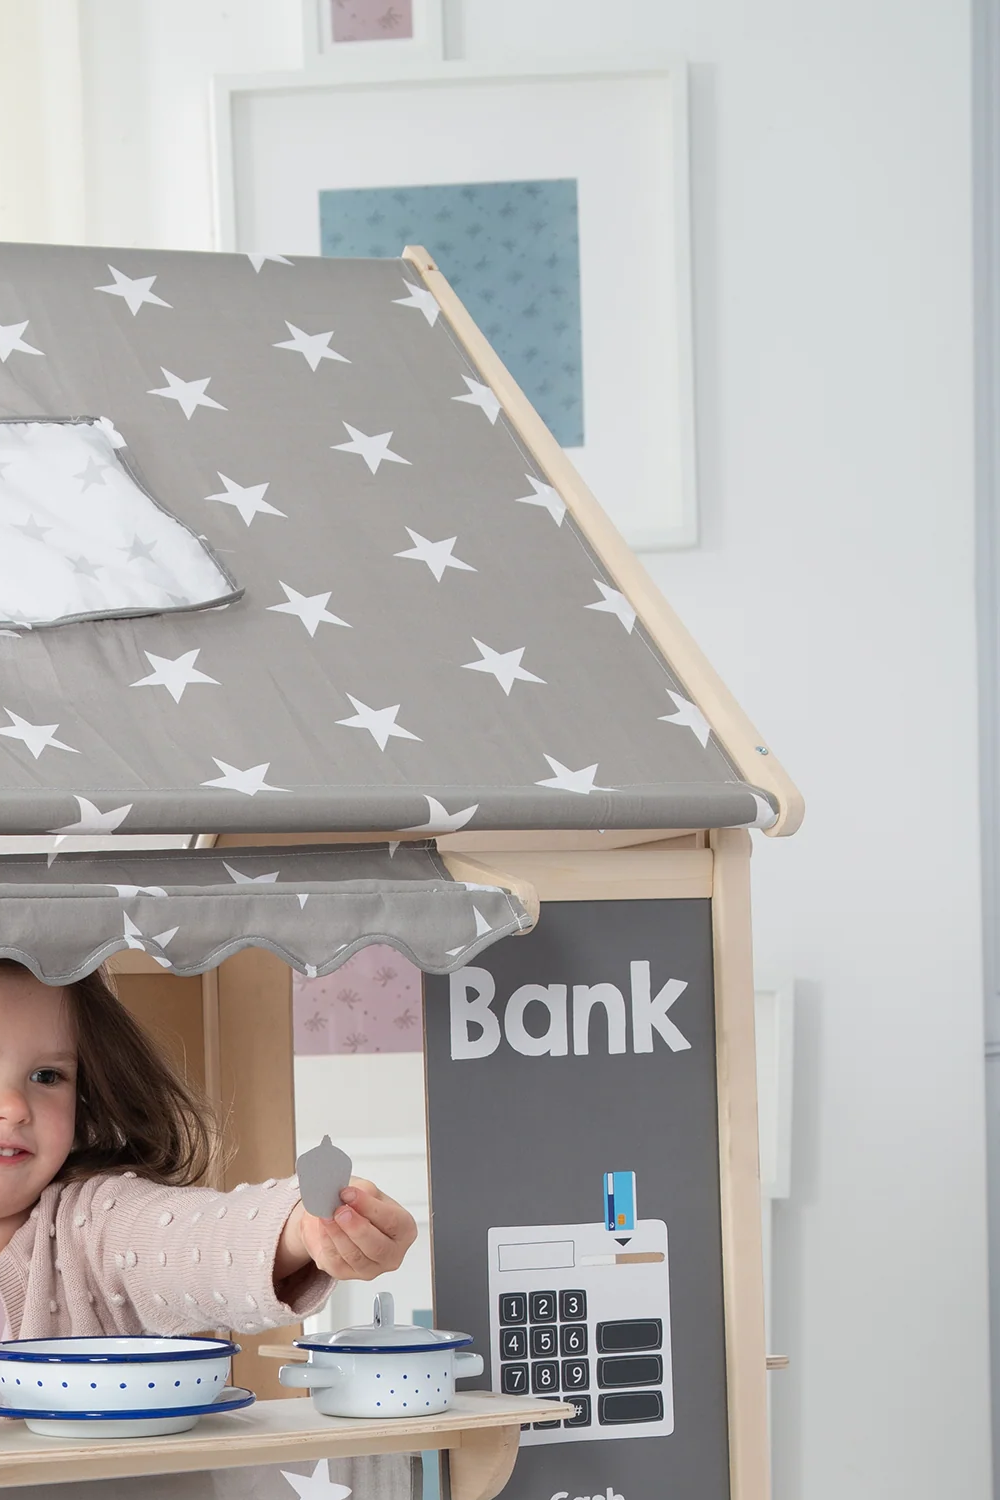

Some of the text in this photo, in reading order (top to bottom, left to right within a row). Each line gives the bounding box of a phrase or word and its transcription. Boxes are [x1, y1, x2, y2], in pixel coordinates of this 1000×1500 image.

[450, 960, 692, 1060] Bank
[510, 1297, 578, 1317] 1 2 3
[508, 1332, 579, 1351] 4 5 6
[511, 1366, 583, 1388] 7 8 9
